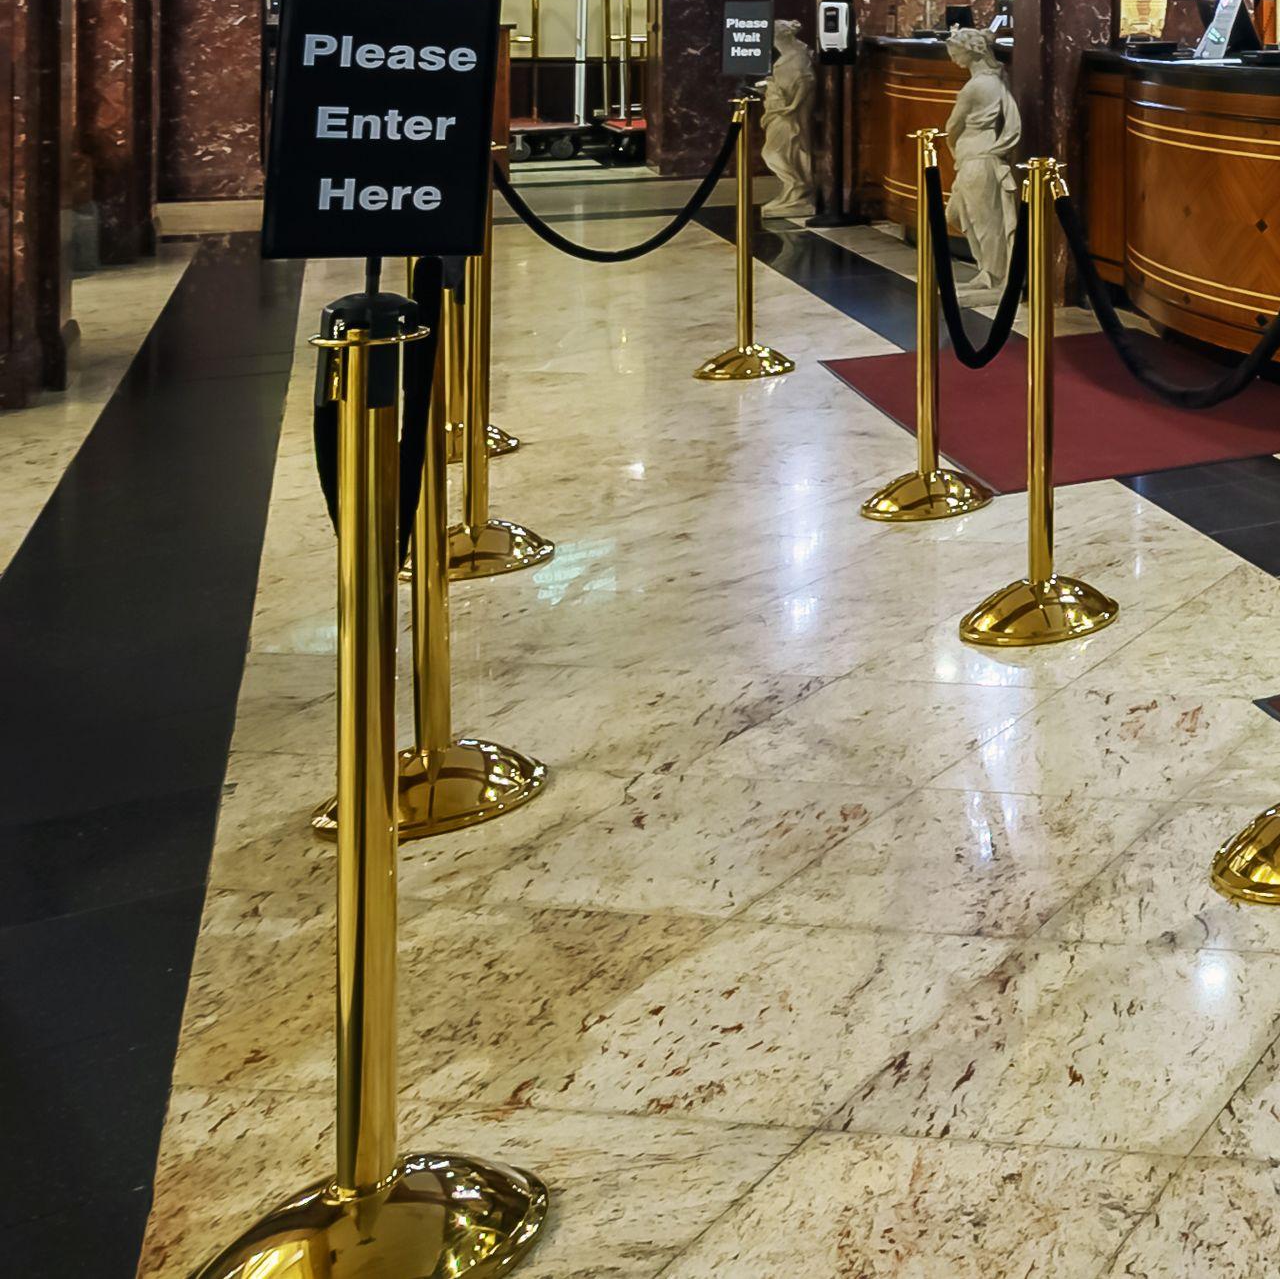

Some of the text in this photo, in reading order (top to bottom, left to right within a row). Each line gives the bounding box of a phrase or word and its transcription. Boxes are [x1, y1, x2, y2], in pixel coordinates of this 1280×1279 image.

[726, 18, 768, 28] Please
[732, 32, 761, 43] Wait
[302, 33, 477, 72] Please
[731, 46, 762, 57] Here
[315, 105, 456, 141] Enter
[318, 177, 442, 211] Here
